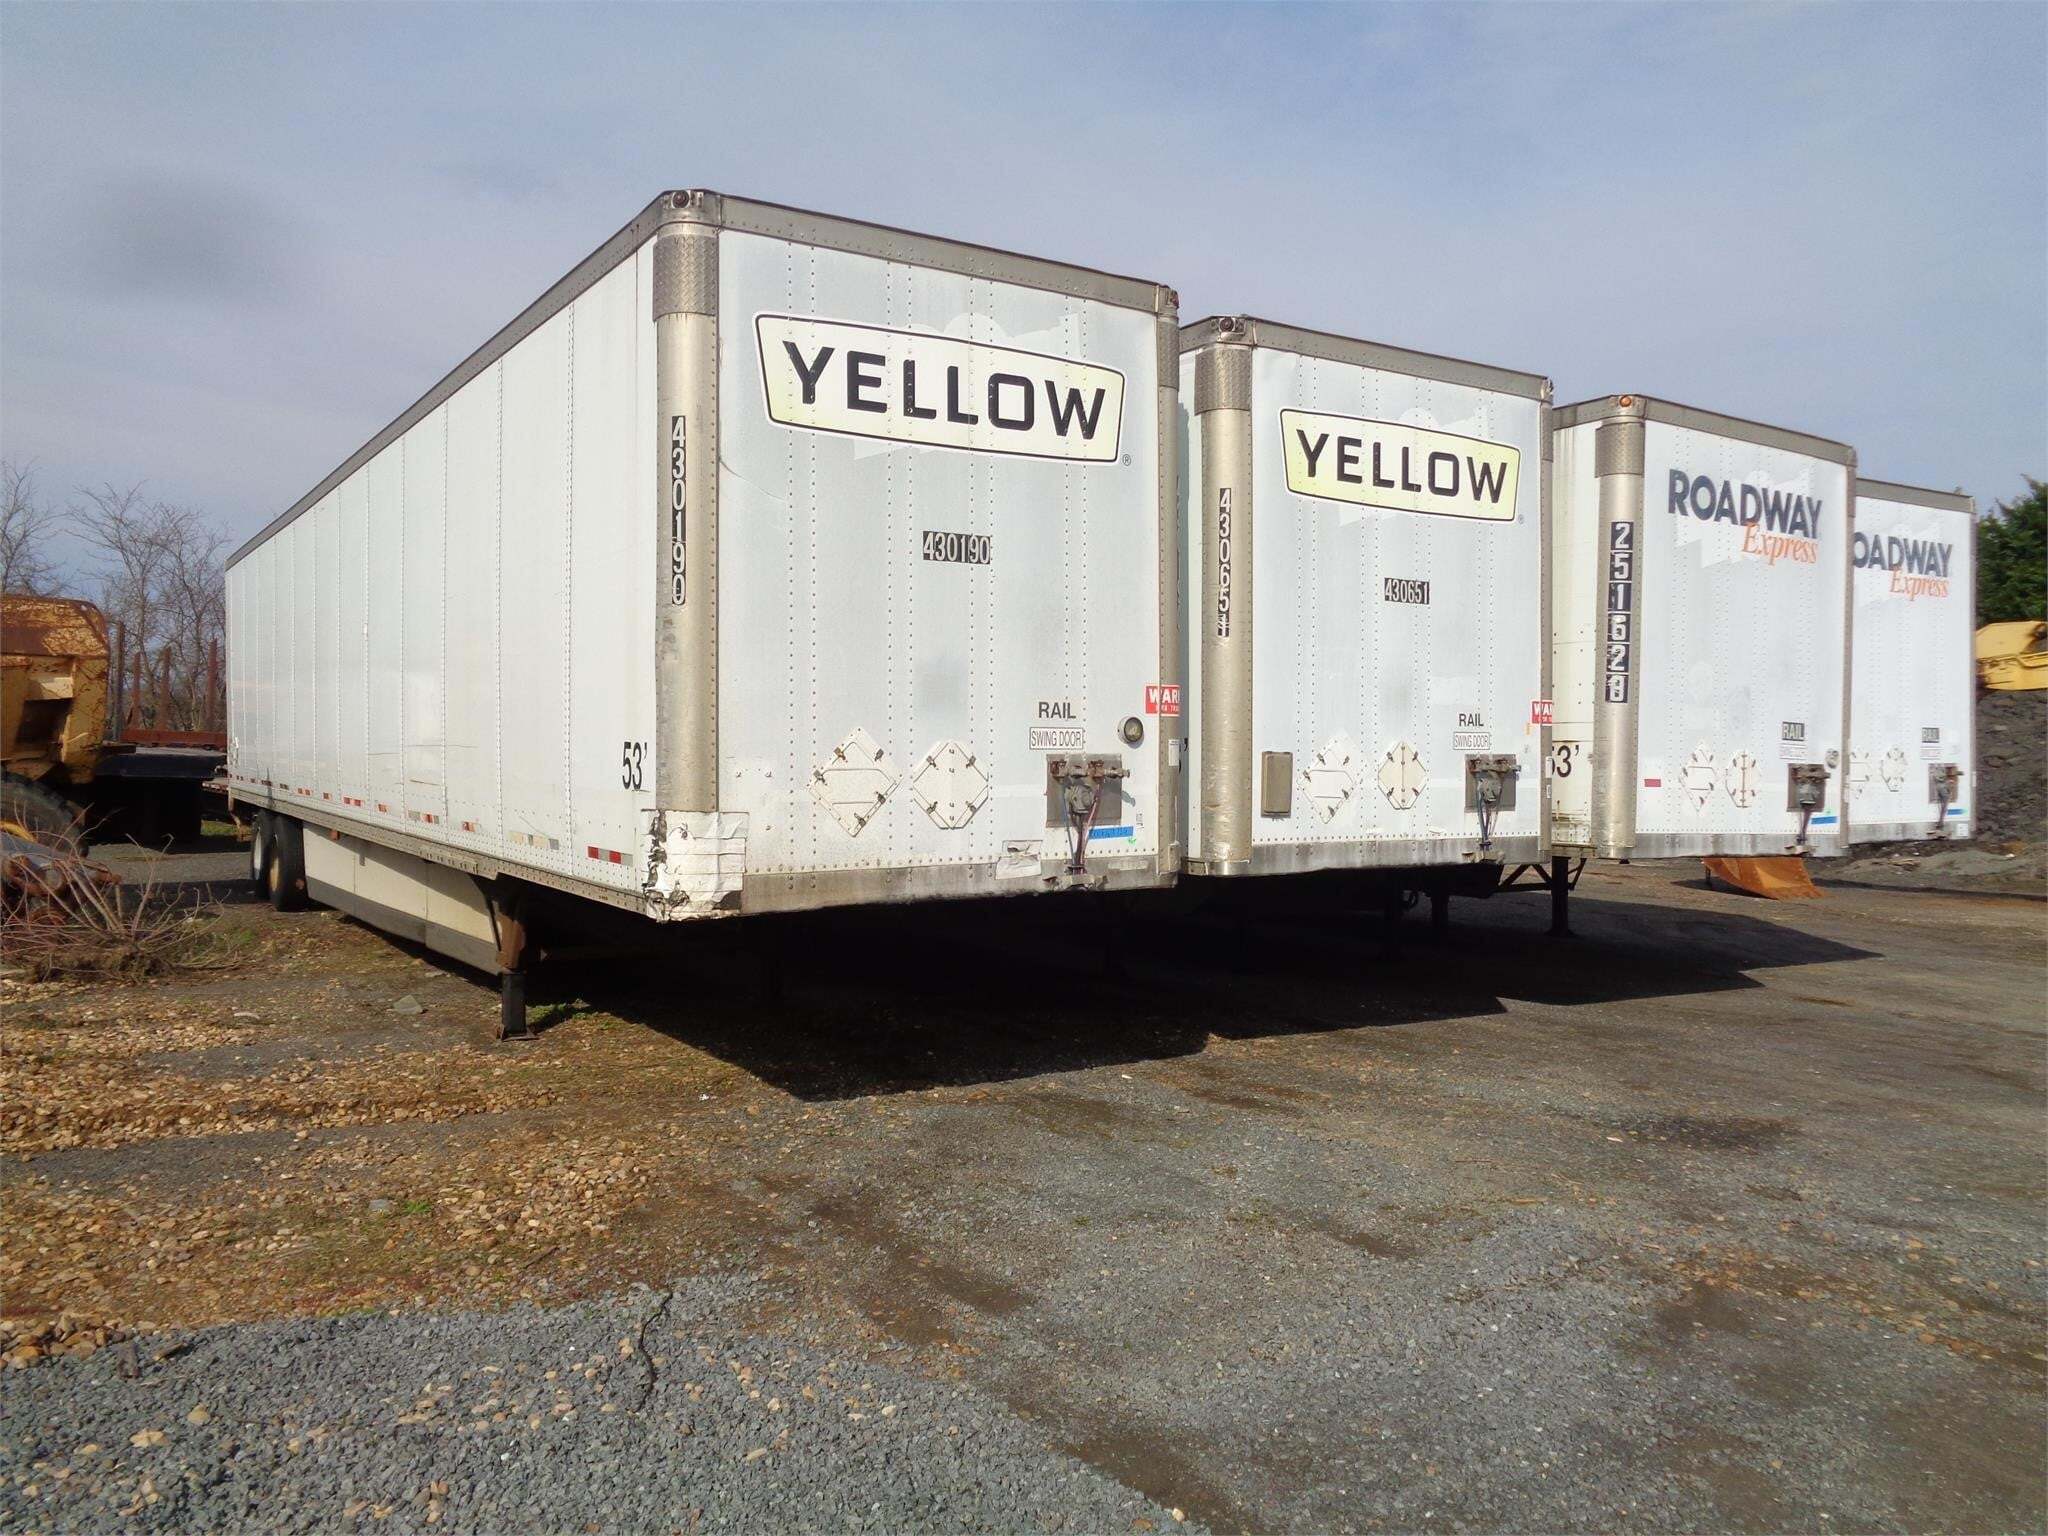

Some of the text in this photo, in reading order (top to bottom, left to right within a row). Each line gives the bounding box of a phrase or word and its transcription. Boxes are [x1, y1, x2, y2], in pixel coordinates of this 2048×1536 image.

[783, 340, 1106, 440] YELLOW
[1296, 428, 1507, 504] YELLOW
[672, 415, 687, 606] 430190
[1668, 469, 1823, 539] ROADWAY
[923, 531, 990, 565] 430190
[1741, 521, 1818, 567] Express
[1852, 531, 1953, 578] OADWAY
[1384, 578, 1429, 605] 430651
[1890, 566, 1949, 601] Express
[1038, 701, 1077, 719] RAIL
[1148, 688, 1180, 704] WAR
[1533, 703, 1552, 716] WA
[1458, 713, 1484, 727] RAIL
[1781, 722, 1805, 741] RAIL
[1031, 730, 1081, 747] SWING DOOR
[622, 741, 648, 790] 53'
[1552, 744, 1579, 778] 3'
